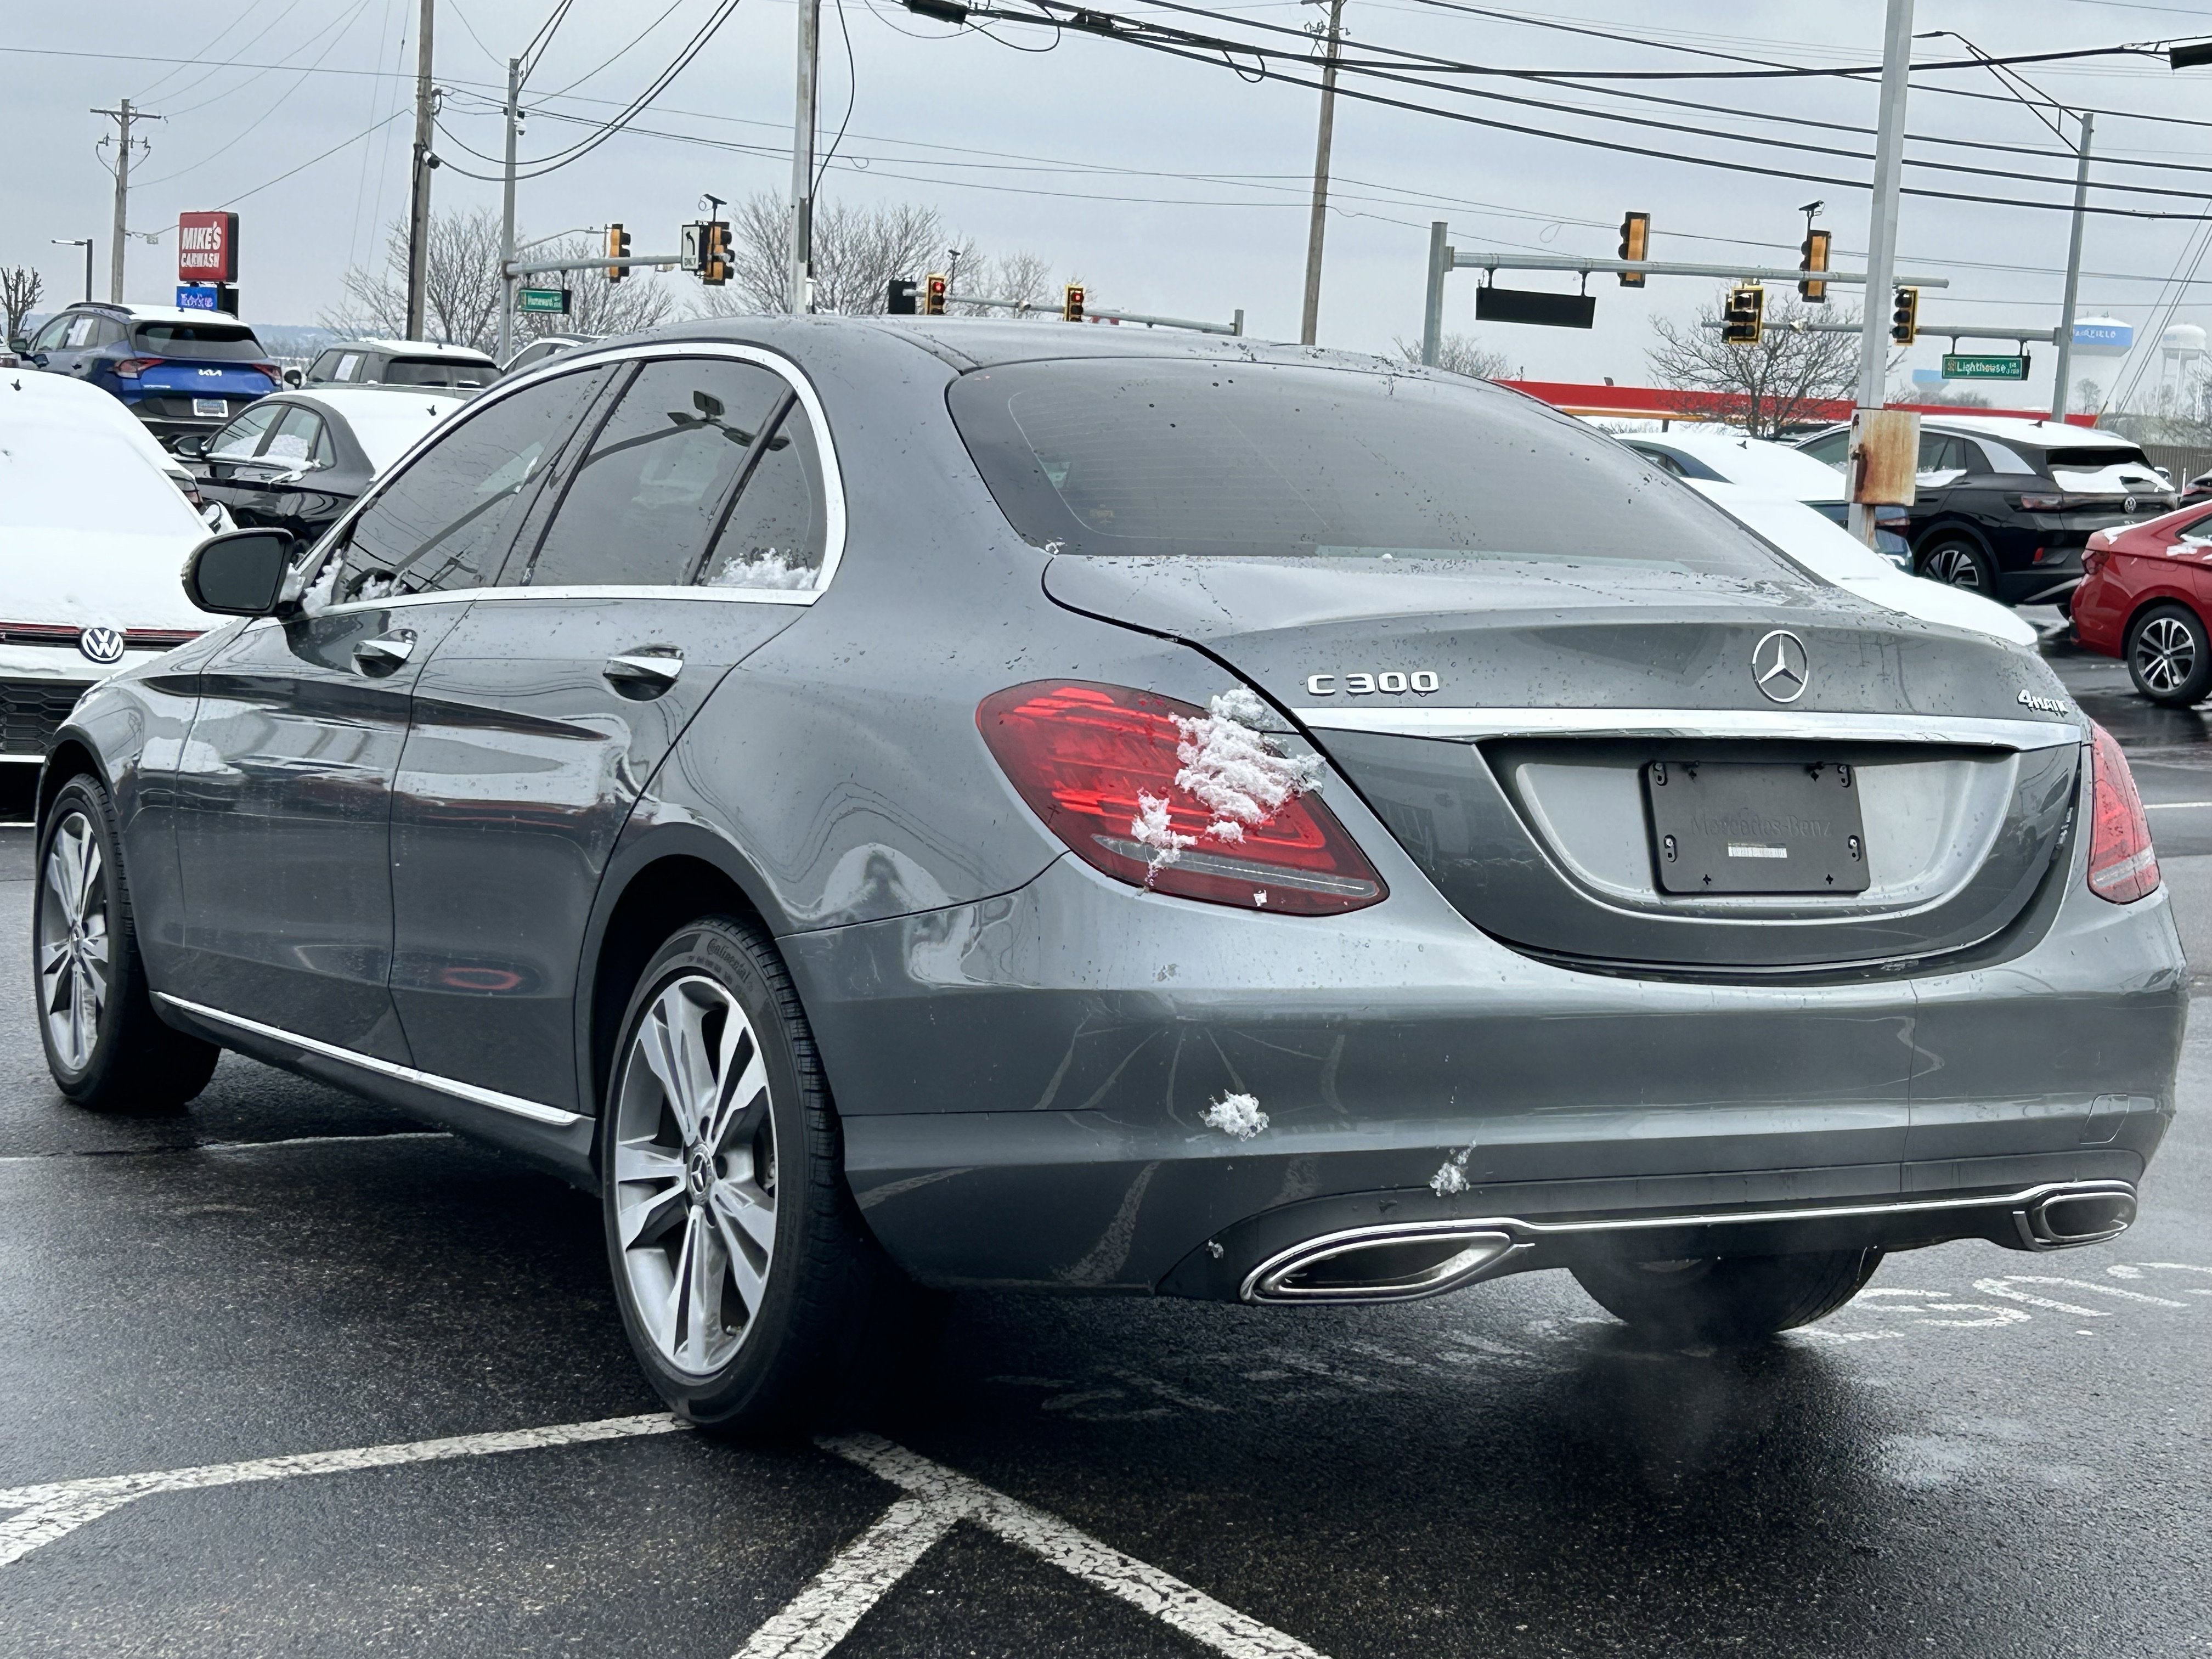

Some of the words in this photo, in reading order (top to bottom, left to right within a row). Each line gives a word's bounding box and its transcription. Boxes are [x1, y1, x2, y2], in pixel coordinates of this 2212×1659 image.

[182, 221, 222, 250] MIKE'S
[1957, 361, 2006, 375] Lighthouse
[1307, 674, 1336, 696] C
[1345, 670, 1440, 696] 300
